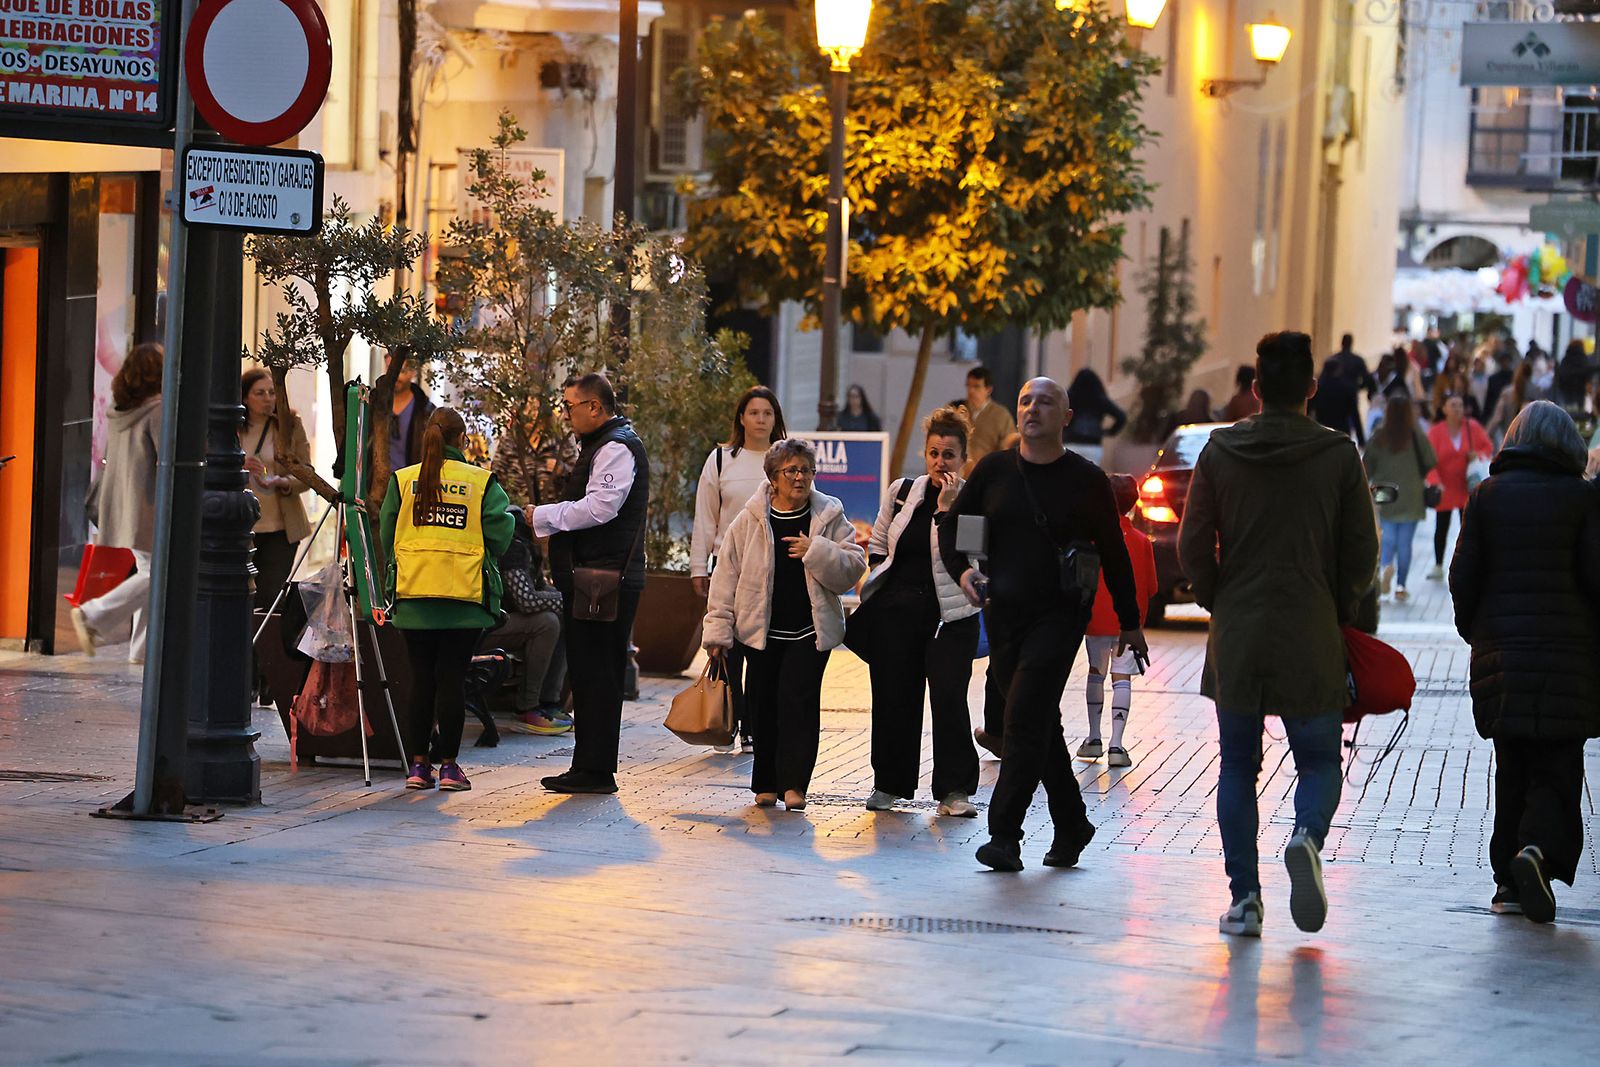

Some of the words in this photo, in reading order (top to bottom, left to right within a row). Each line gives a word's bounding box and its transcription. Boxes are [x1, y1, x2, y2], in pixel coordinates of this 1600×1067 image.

[45, 0, 73, 15] DE
[79, 0, 151, 21] BOLAS
[0, 18, 150, 48] LEBRACIONES
[0, 51, 26, 68] OS
[45, 54, 151, 77] DESAYUNOS
[8, 82, 106, 110] MARINA,
[136, 90, 158, 112] 14
[187, 155, 222, 181] EXCEPTO
[223, 158, 270, 186] RESIDENTES
[271, 161, 278, 187] Y
[278, 163, 313, 190] GARAJES
[233, 192, 244, 217] DE
[245, 193, 278, 220] AGOSTO
[439, 483, 467, 496] NCE
